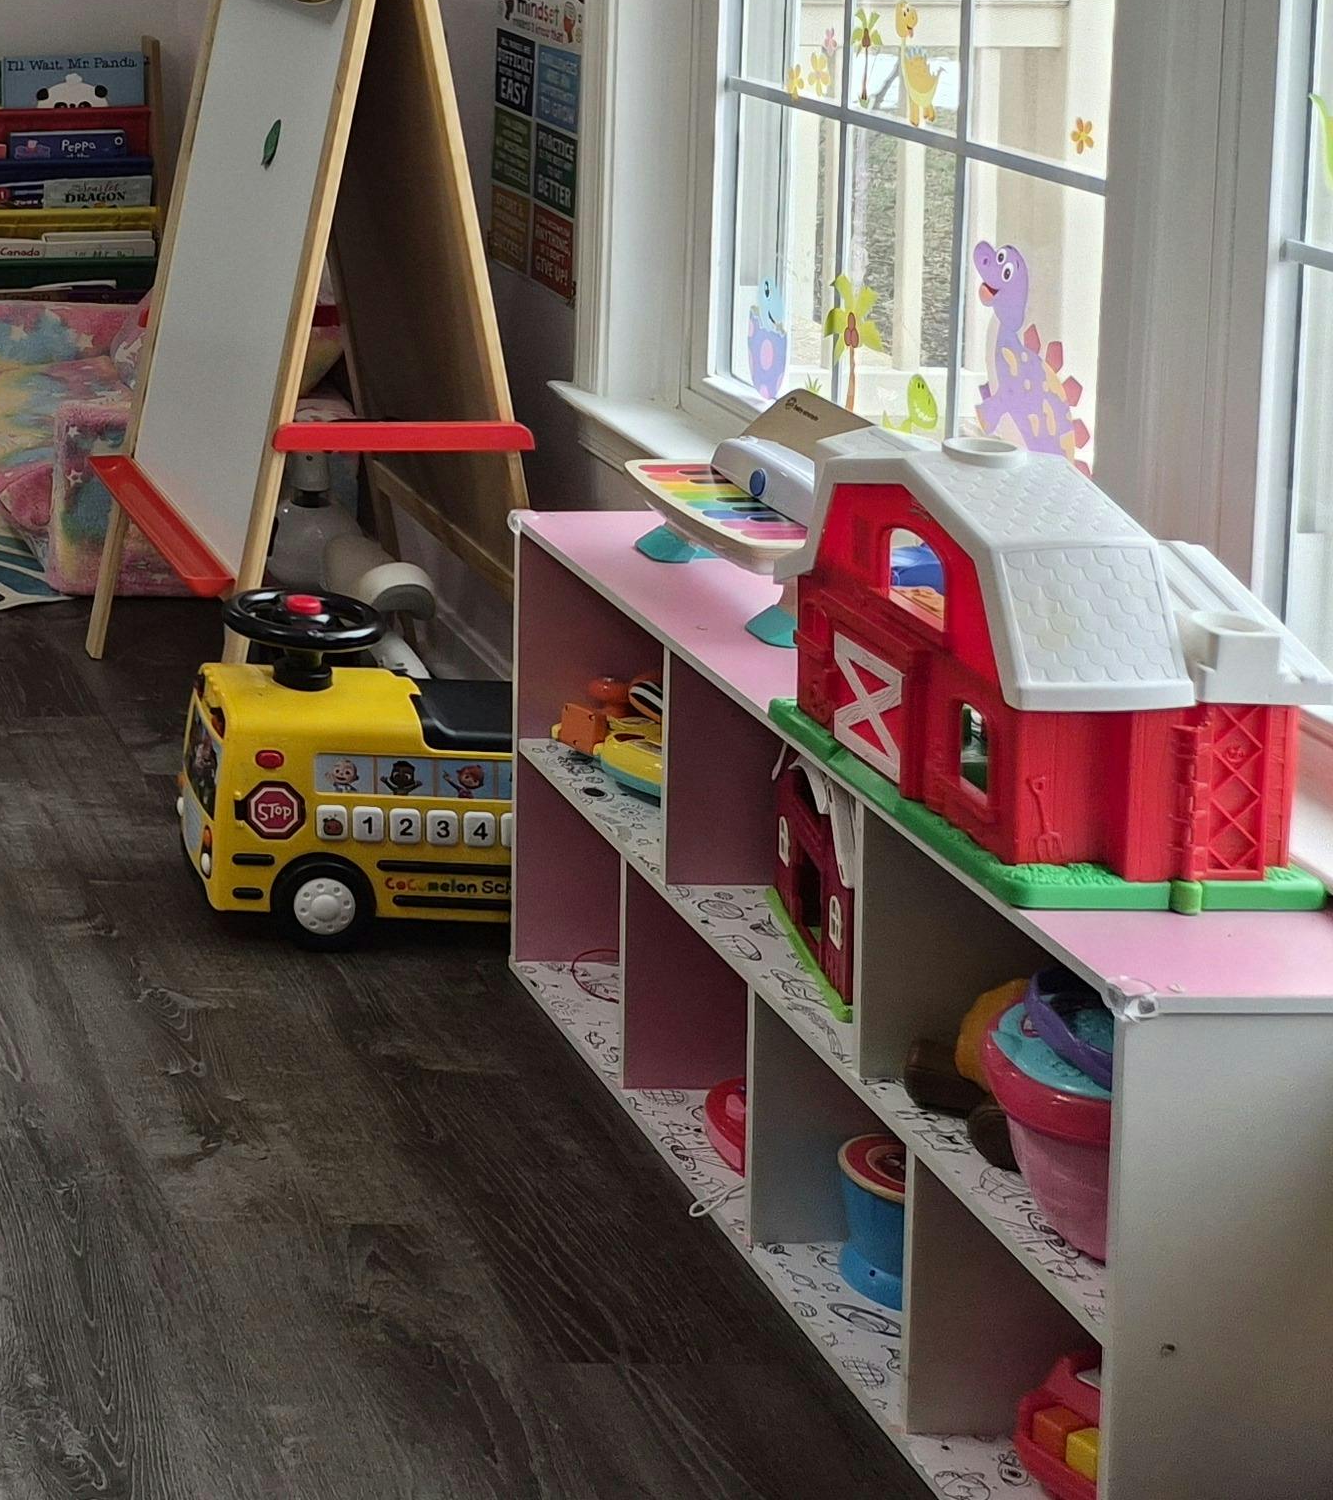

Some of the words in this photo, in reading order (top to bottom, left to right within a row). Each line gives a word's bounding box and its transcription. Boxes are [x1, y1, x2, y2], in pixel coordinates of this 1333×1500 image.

[7, 60, 25, 71] I'll
[94, 56, 138, 70] Panda
[500, 77, 528, 107] EASY
[61, 139, 96, 153] Peppa
[65, 191, 126, 204] DRAGON
[538, 175, 572, 208] BETTER
[0, 247, 41, 257] Canada
[257, 801, 292, 824] STOP
[362, 816, 373, 835] 1
[399, 818, 414, 836] 2
[436, 820, 451, 838] 3
[473, 822, 488, 840] 4
